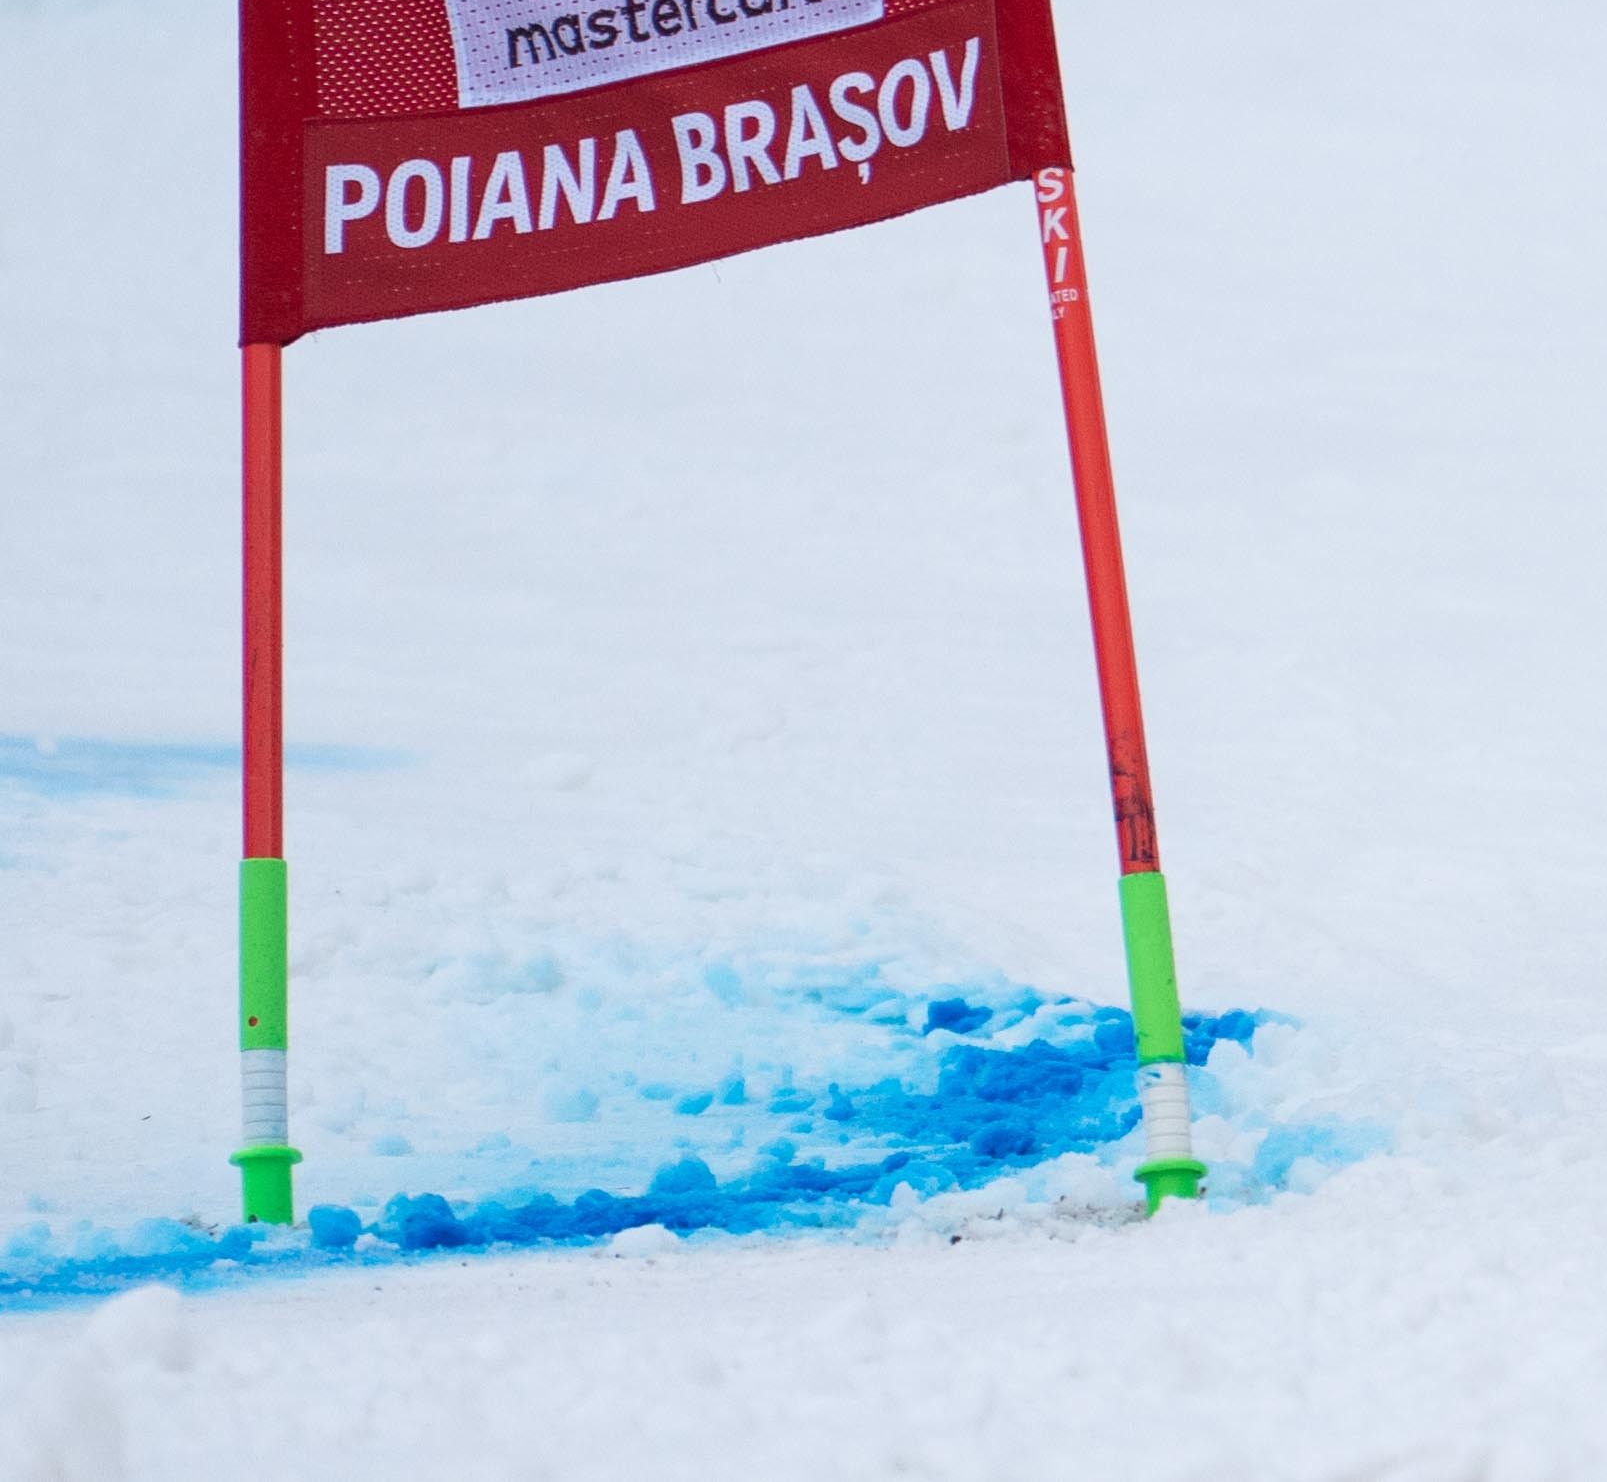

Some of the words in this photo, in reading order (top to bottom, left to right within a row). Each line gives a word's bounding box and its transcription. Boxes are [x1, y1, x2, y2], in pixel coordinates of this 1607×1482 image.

[323, 129, 656, 256] POIANA
[672, 36, 983, 205] BRAȘOV
[1037, 166, 1070, 284] SKI
